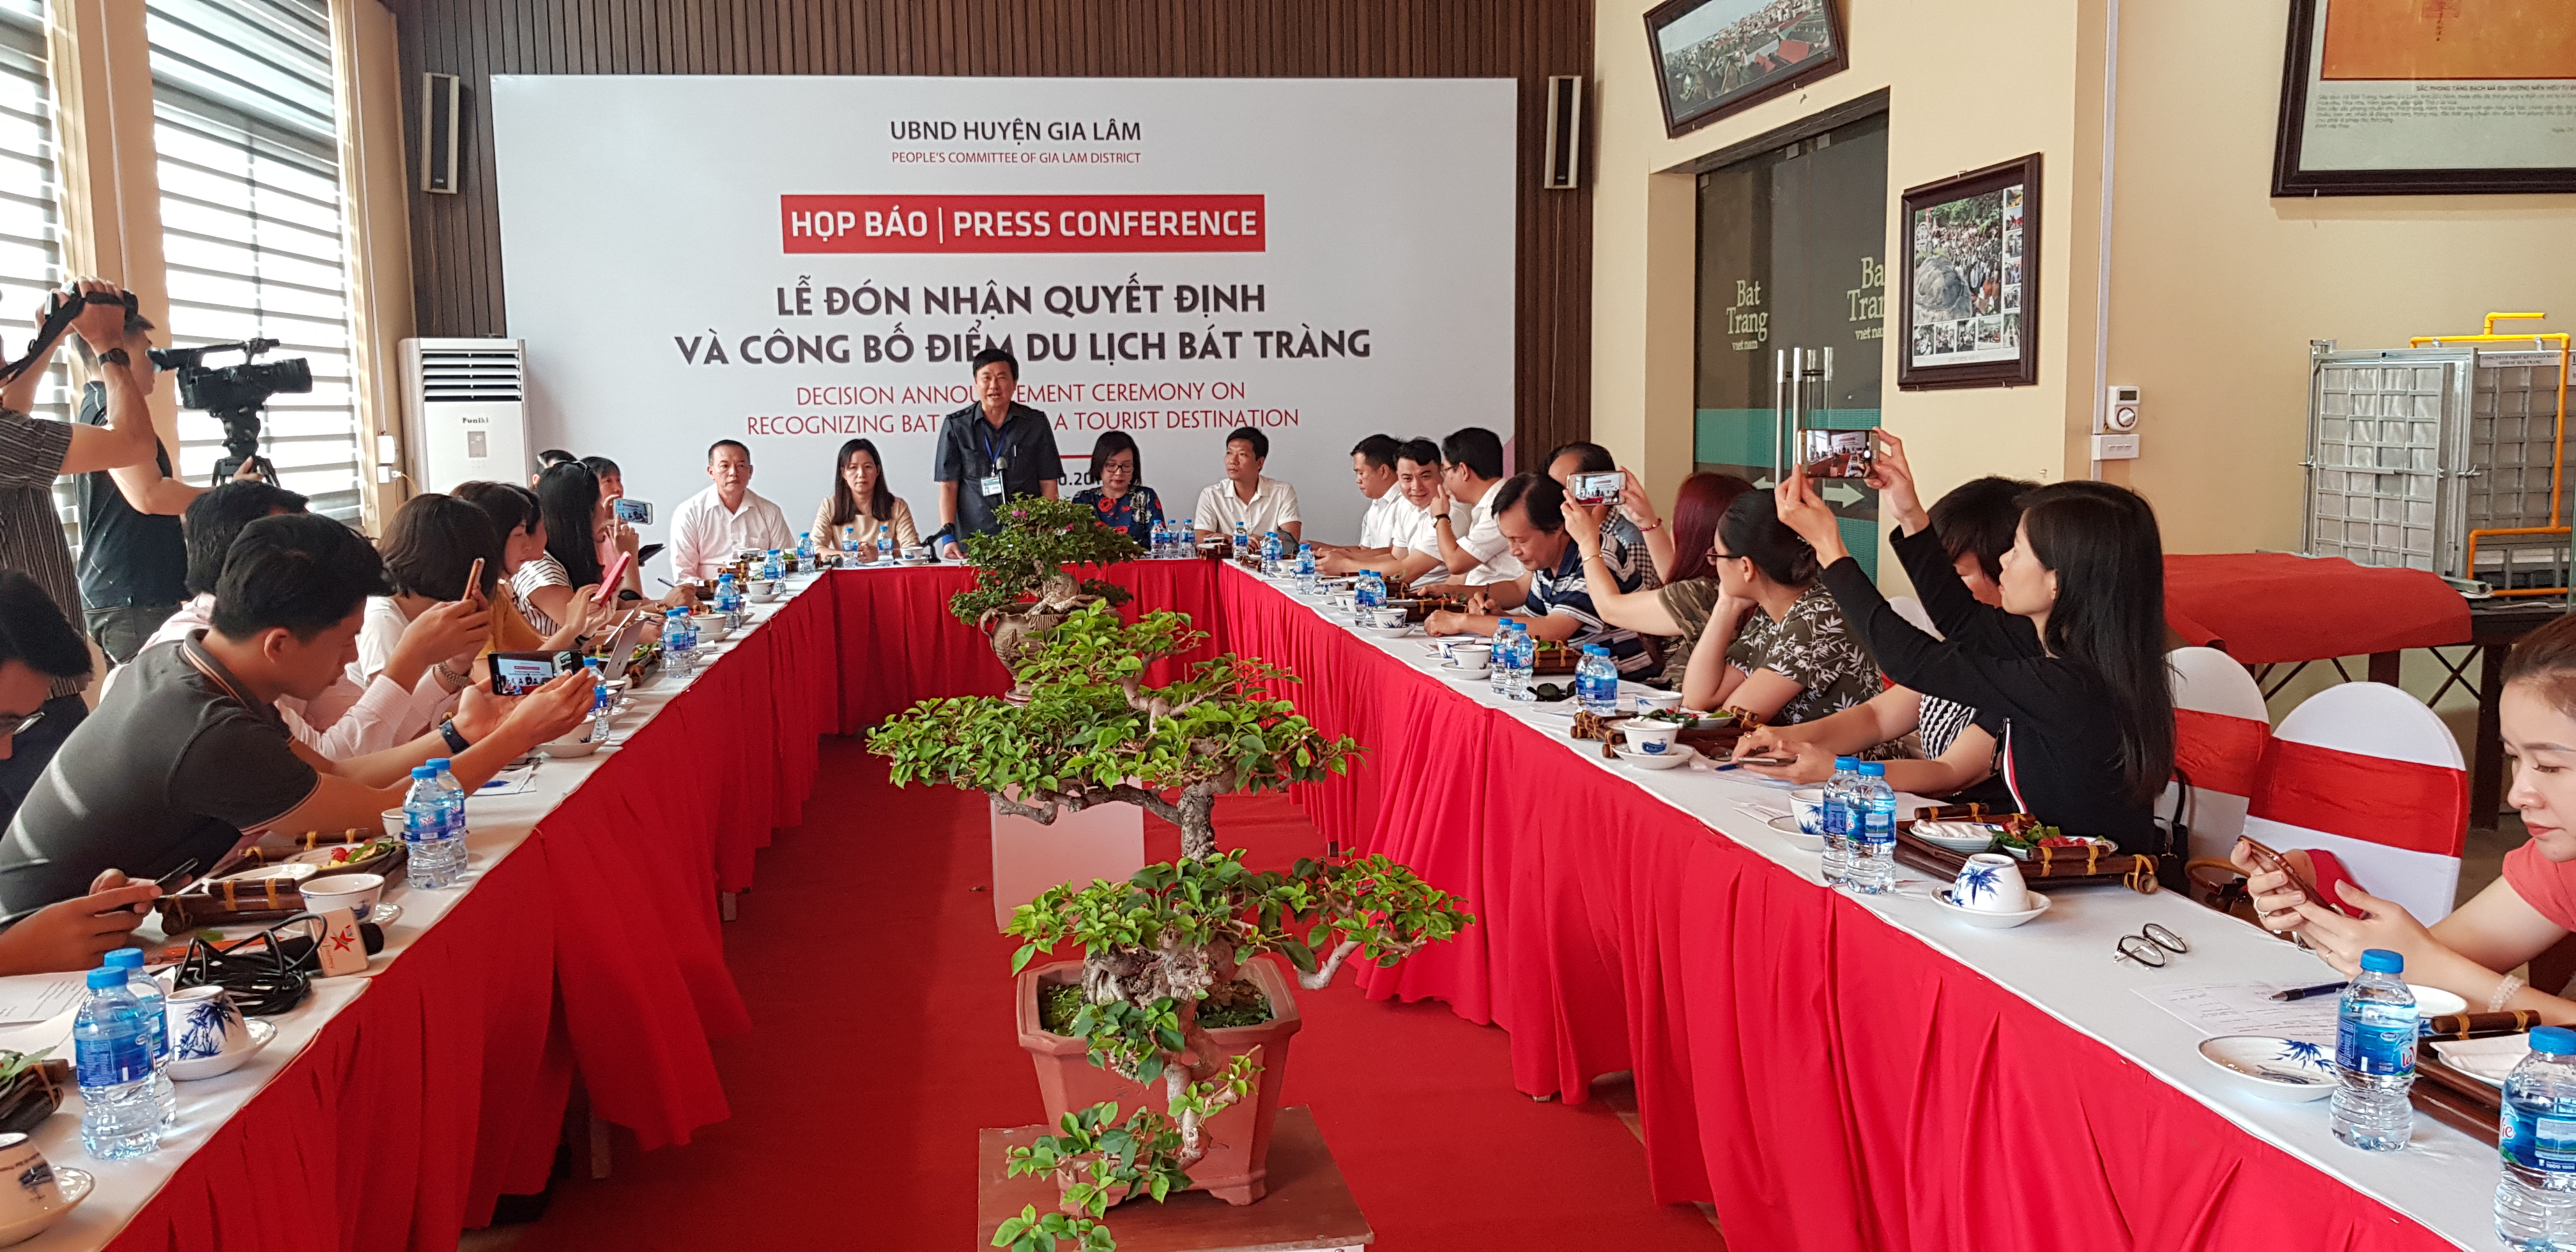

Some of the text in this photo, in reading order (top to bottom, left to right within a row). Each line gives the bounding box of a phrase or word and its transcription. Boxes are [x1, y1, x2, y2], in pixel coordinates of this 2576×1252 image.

[891, 118, 1142, 146] UBND HUYỆN GIA LÂM
[892, 151, 1142, 164] PEOPLE'S COMMITTEE OF GIA LAM DISTRICT
[792, 205, 1257, 242] HỌP BÁO PRESS CONFERENCE
[1860, 256, 1885, 289] Ba
[777, 271, 1266, 319] LỄ ĐÓN NHẬN QUYẾT ĐỊNH
[1736, 279, 1761, 307] Bat
[1726, 306, 1769, 342] Trang
[674, 328, 729, 365] VÀ
[740, 327, 850, 364] CÔNG
[863, 321, 914, 363] BỐ
[1027, 332, 1077, 362] DU
[1089, 332, 1165, 366] LỊCH
[1179, 323, 1243, 360] BÁT
[1253, 322, 1371, 359] TRÀNG
[797, 381, 1245, 406] DECISION ANNOUEMENT CEREMONY ON
[747, 408, 1299, 435] RECOGNIZING BAT A TOURIST DESTINATION
